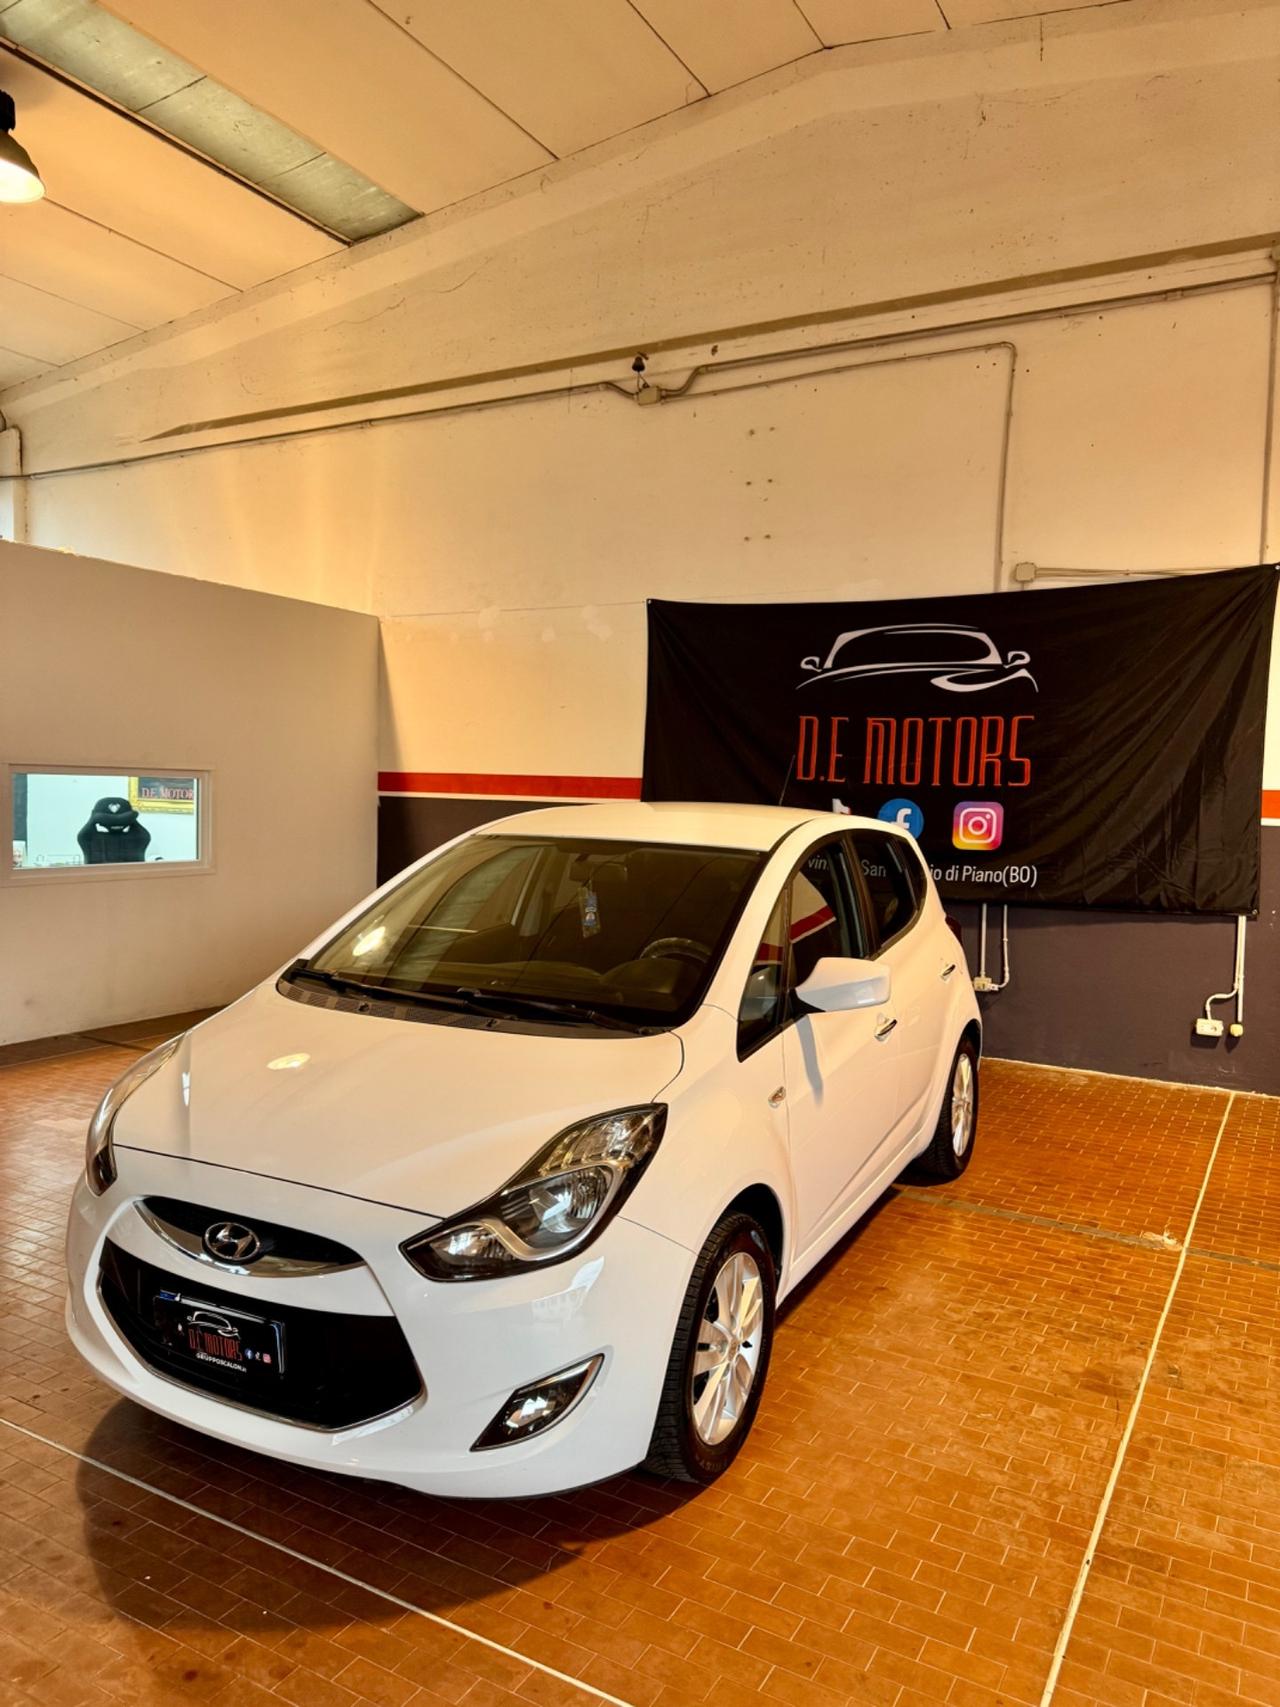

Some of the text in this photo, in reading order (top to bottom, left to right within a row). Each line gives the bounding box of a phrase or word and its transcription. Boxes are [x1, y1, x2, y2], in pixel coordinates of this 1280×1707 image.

[796, 715, 1035, 787] D.E MOTORS
[159, 787, 194, 800] MOTOR
[860, 858, 887, 878] San
[945, 864, 960, 882] di
[961, 864, 1038, 888] Piano(BO)
